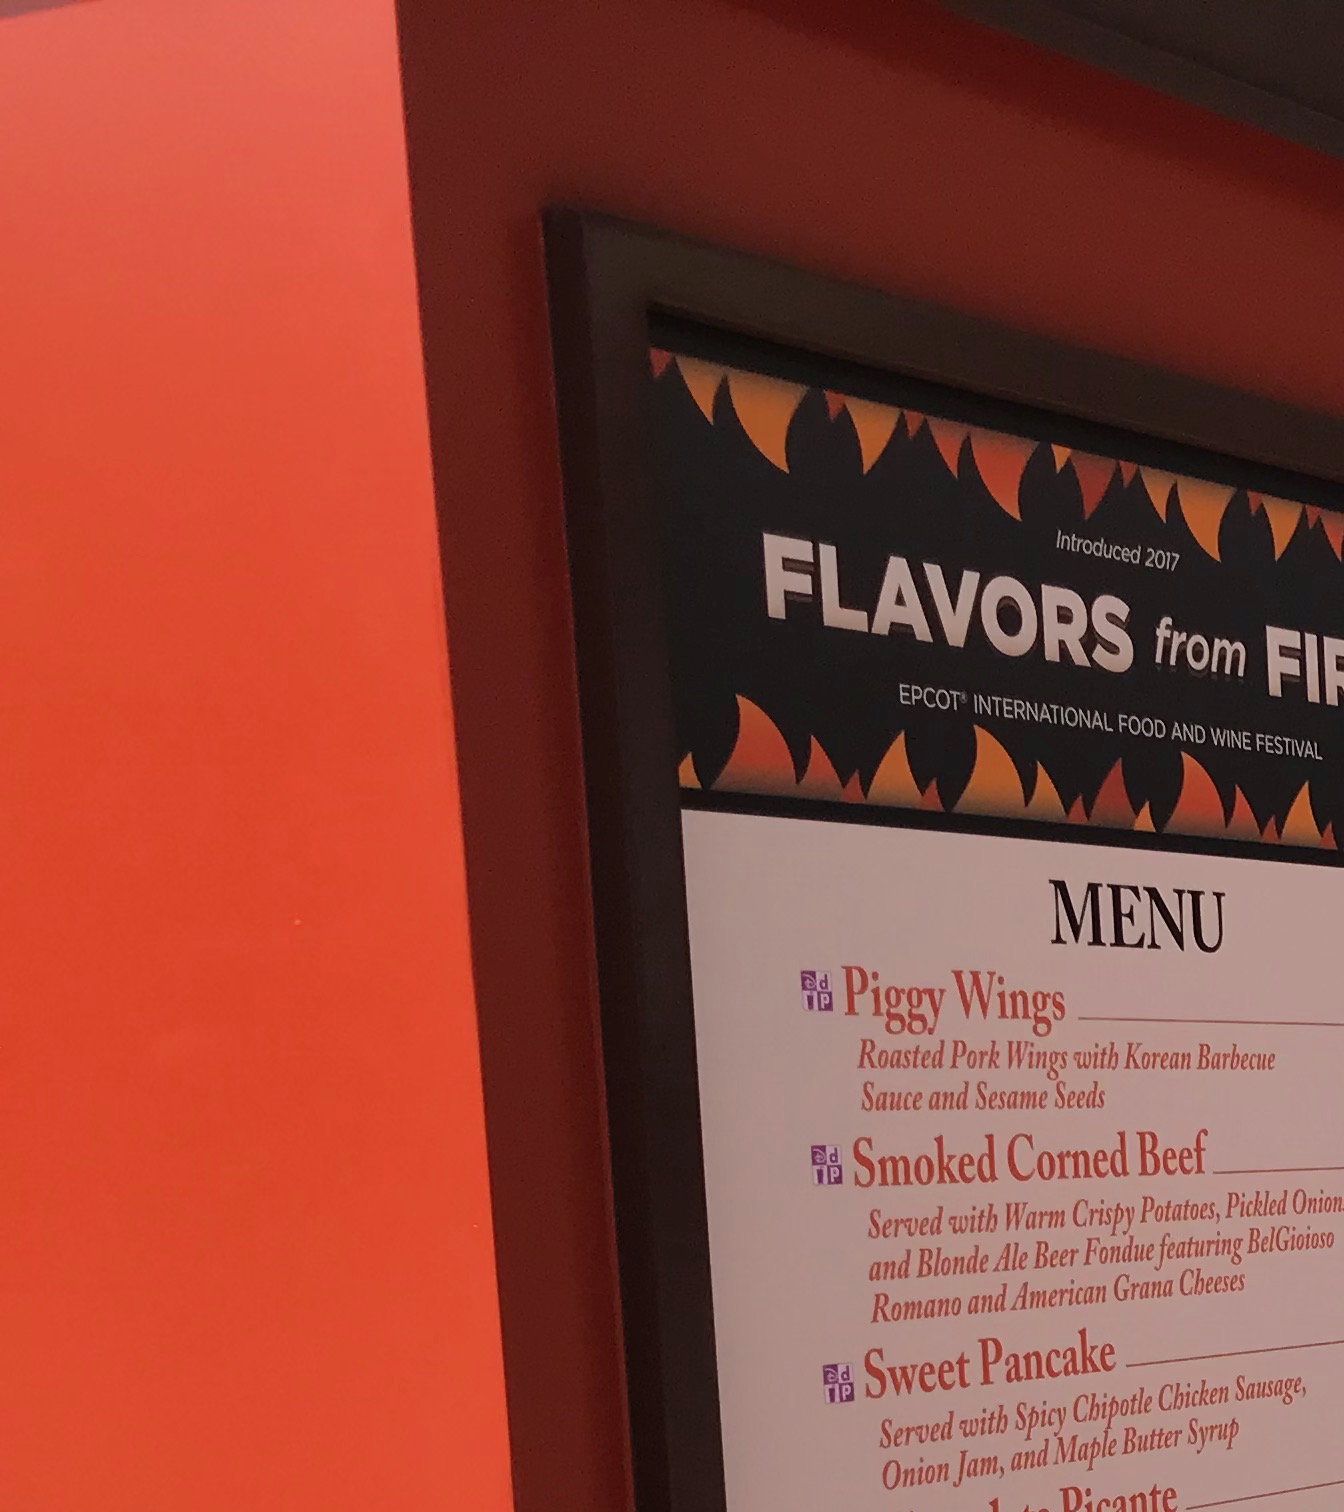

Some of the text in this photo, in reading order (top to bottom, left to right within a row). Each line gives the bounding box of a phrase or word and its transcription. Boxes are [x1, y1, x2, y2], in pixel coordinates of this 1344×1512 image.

[1055, 528, 1181, 572] Introduced 2017
[762, 532, 1134, 673] FLAVORS
[1154, 615, 1247, 677] from
[973, 692, 1114, 733] INTERNATIONAL
[1117, 713, 1167, 739] FOOD
[1170, 720, 1207, 745] AND
[1209, 725, 1253, 752] WINE
[1254, 732, 1324, 761] FESTIVAL
[1047, 878, 1227, 954] MENU
[840, 964, 947, 1036] Piggy
[950, 968, 1066, 1038] Wings
[856, 1037, 1276, 1082] Roasted Pork Wings with Korean Barbecue
[860, 1080, 1106, 1113] Sauce and Sesame Seeds
[851, 1132, 999, 1189] Smoked
[1006, 1129, 1131, 1182] Corned
[1135, 1127, 1209, 1177] Beef
[867, 1204, 944, 1240] Served
[947, 1201, 999, 1235] with
[1004, 1200, 1067, 1232] Warm
[1071, 1198, 1136, 1237] Crispy
[1139, 1194, 1221, 1225] Potatoes,
[1224, 1188, 1289, 1219] Pickled
[867, 1224, 1335, 1282] and Blonde Ale Beer Fondue featuring BelGioioso
[869, 1266, 1246, 1324] Romano and American Grana Cheeses
[863, 1346, 971, 1400] Sweet
[976, 1326, 1117, 1387] Pancake
[878, 1374, 1307, 1450] Served with Spicy Chipotle Chicken Sausage,
[881, 1416, 1240, 1491] Onion Jam, and Maple Butter Syrup
